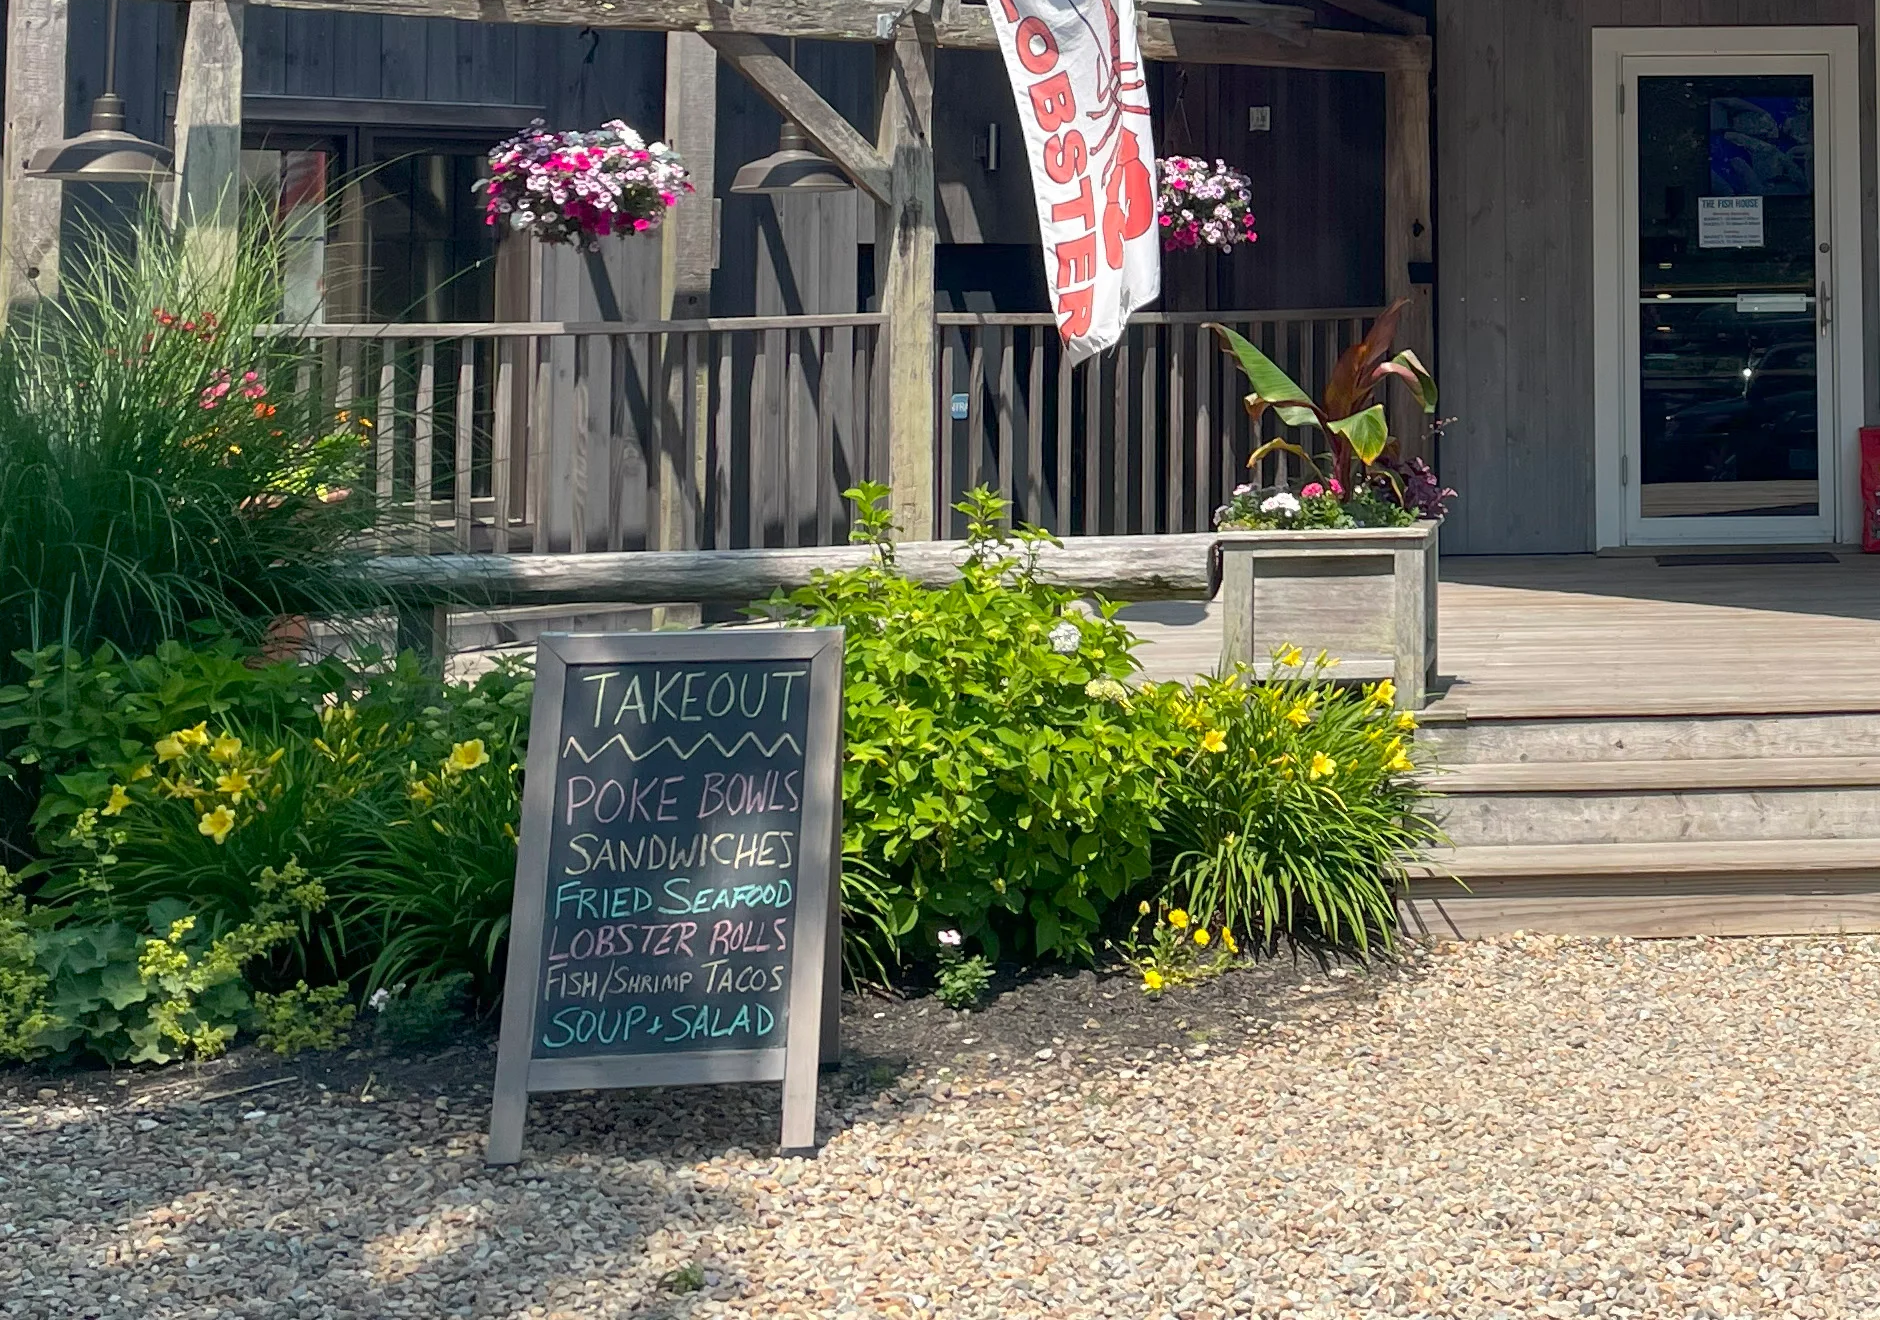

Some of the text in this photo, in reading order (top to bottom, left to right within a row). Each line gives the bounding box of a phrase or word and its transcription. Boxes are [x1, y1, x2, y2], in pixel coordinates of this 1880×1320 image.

[583, 671, 807, 728] TAKEOUT
[566, 769, 800, 826] POKE BOWLS
[565, 831, 794, 876] SANDWICHES
[555, 877, 793, 920] FRIED SEAFOOD
[548, 918, 787, 961] LOBSTER ROLLS
[545, 959, 785, 1002] FISH/SHRIMP TACOS
[543, 1005, 647, 1048] SOUP
[664, 1002, 775, 1042] SALAD
